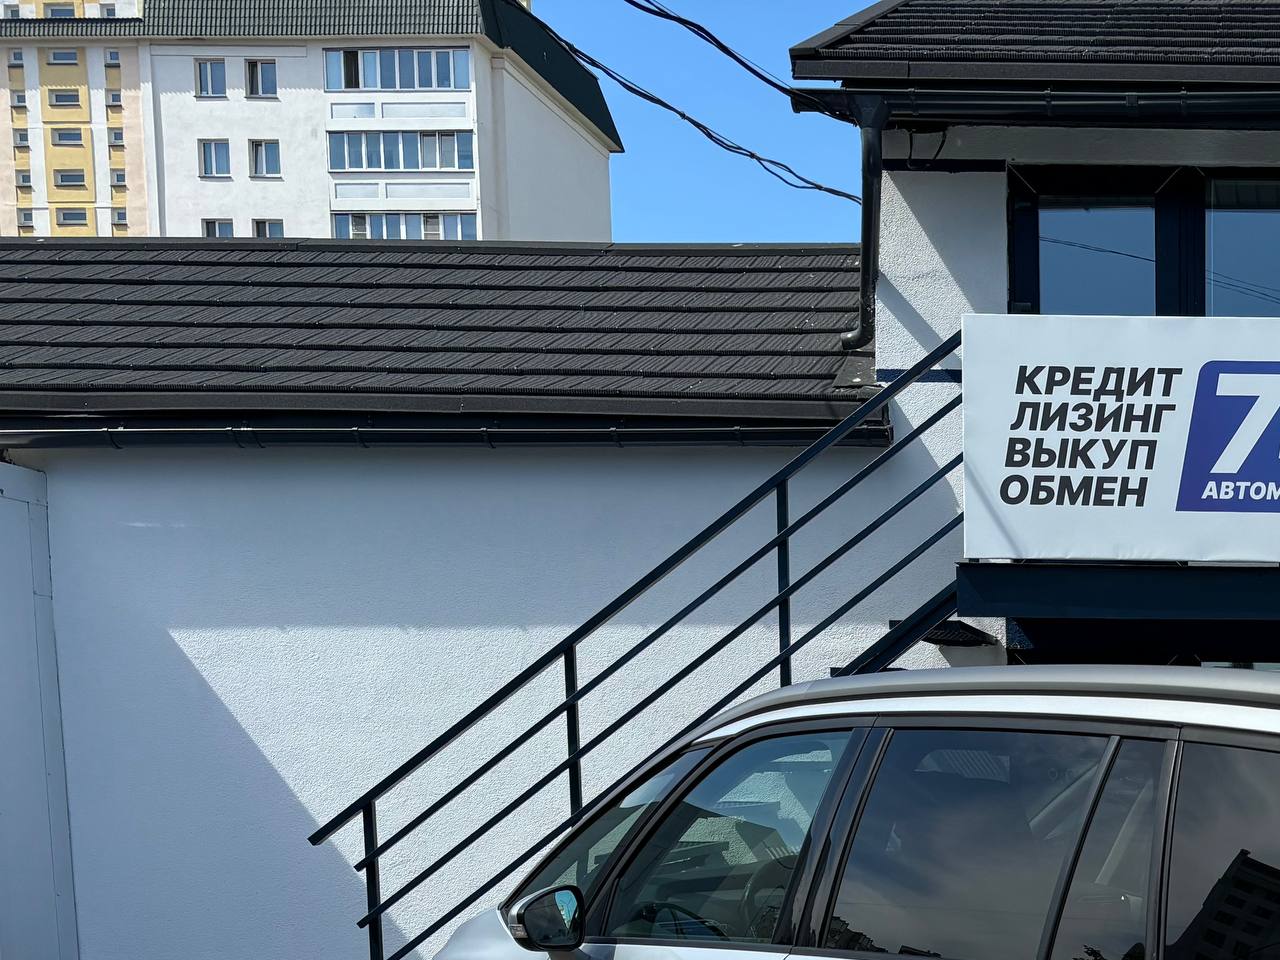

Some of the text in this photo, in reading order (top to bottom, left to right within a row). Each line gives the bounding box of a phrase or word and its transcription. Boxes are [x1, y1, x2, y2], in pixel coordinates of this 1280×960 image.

[1015, 365, 1183, 402] КРЕДИТ
[1010, 402, 1176, 433] ЛИЗИНГ
[1005, 437, 1158, 470] ВЫКУП
[1000, 474, 1148, 507] ОБМЕН
